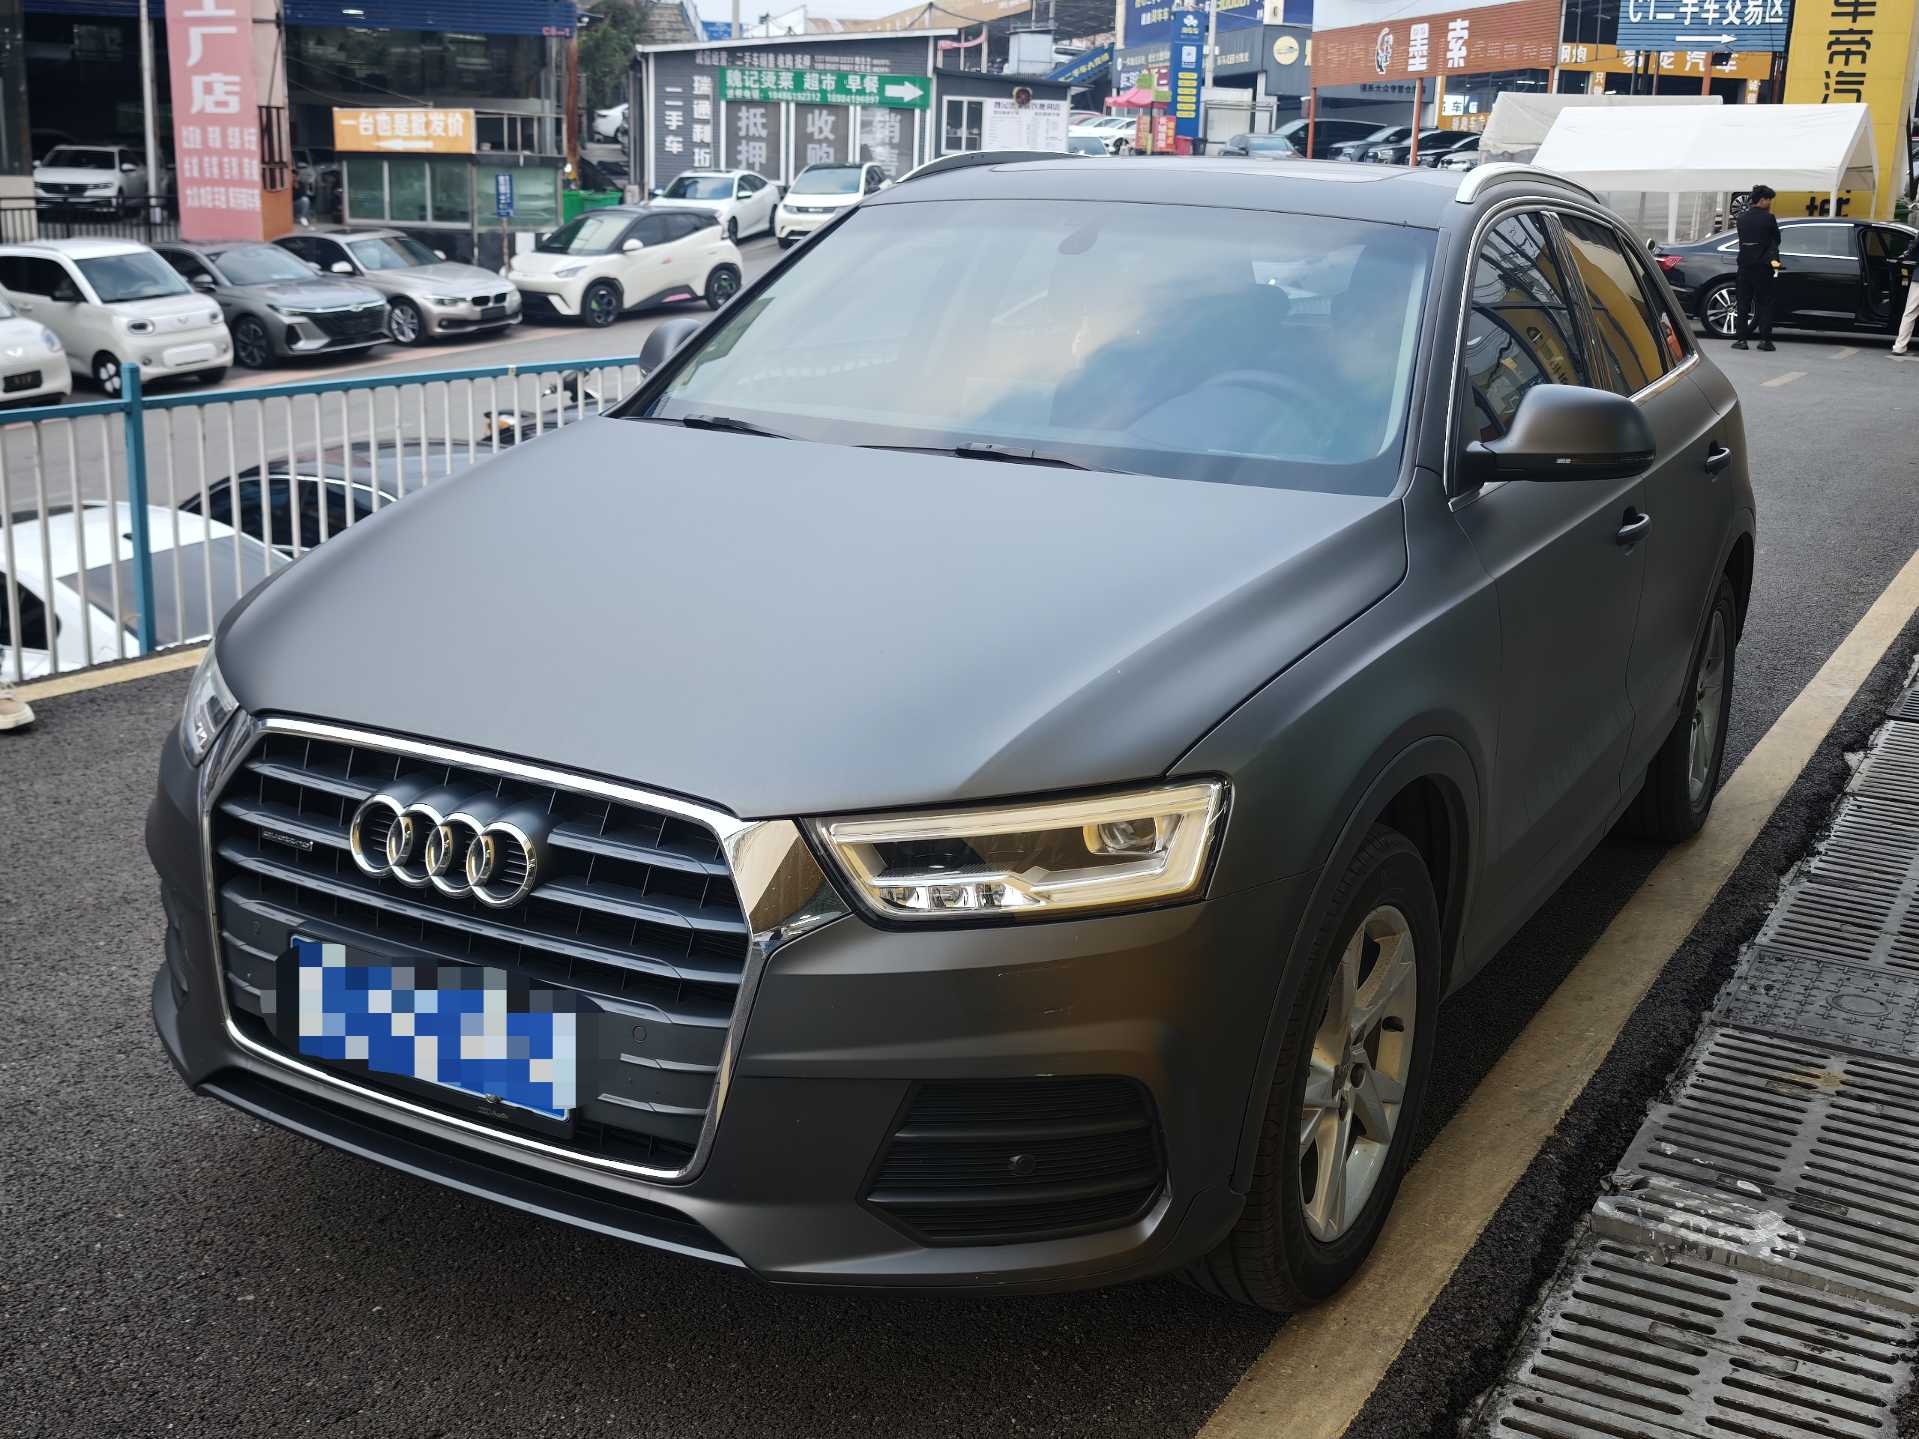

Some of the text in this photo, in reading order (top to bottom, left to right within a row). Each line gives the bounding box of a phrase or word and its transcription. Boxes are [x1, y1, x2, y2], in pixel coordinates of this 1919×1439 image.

[803, 72, 837, 91] 超市
[846, 74, 879, 93] 早餐
[338, 111, 465, 137] 一台也是批发价
[736, 106, 768, 172] 抵押
[806, 109, 835, 165] 收购
